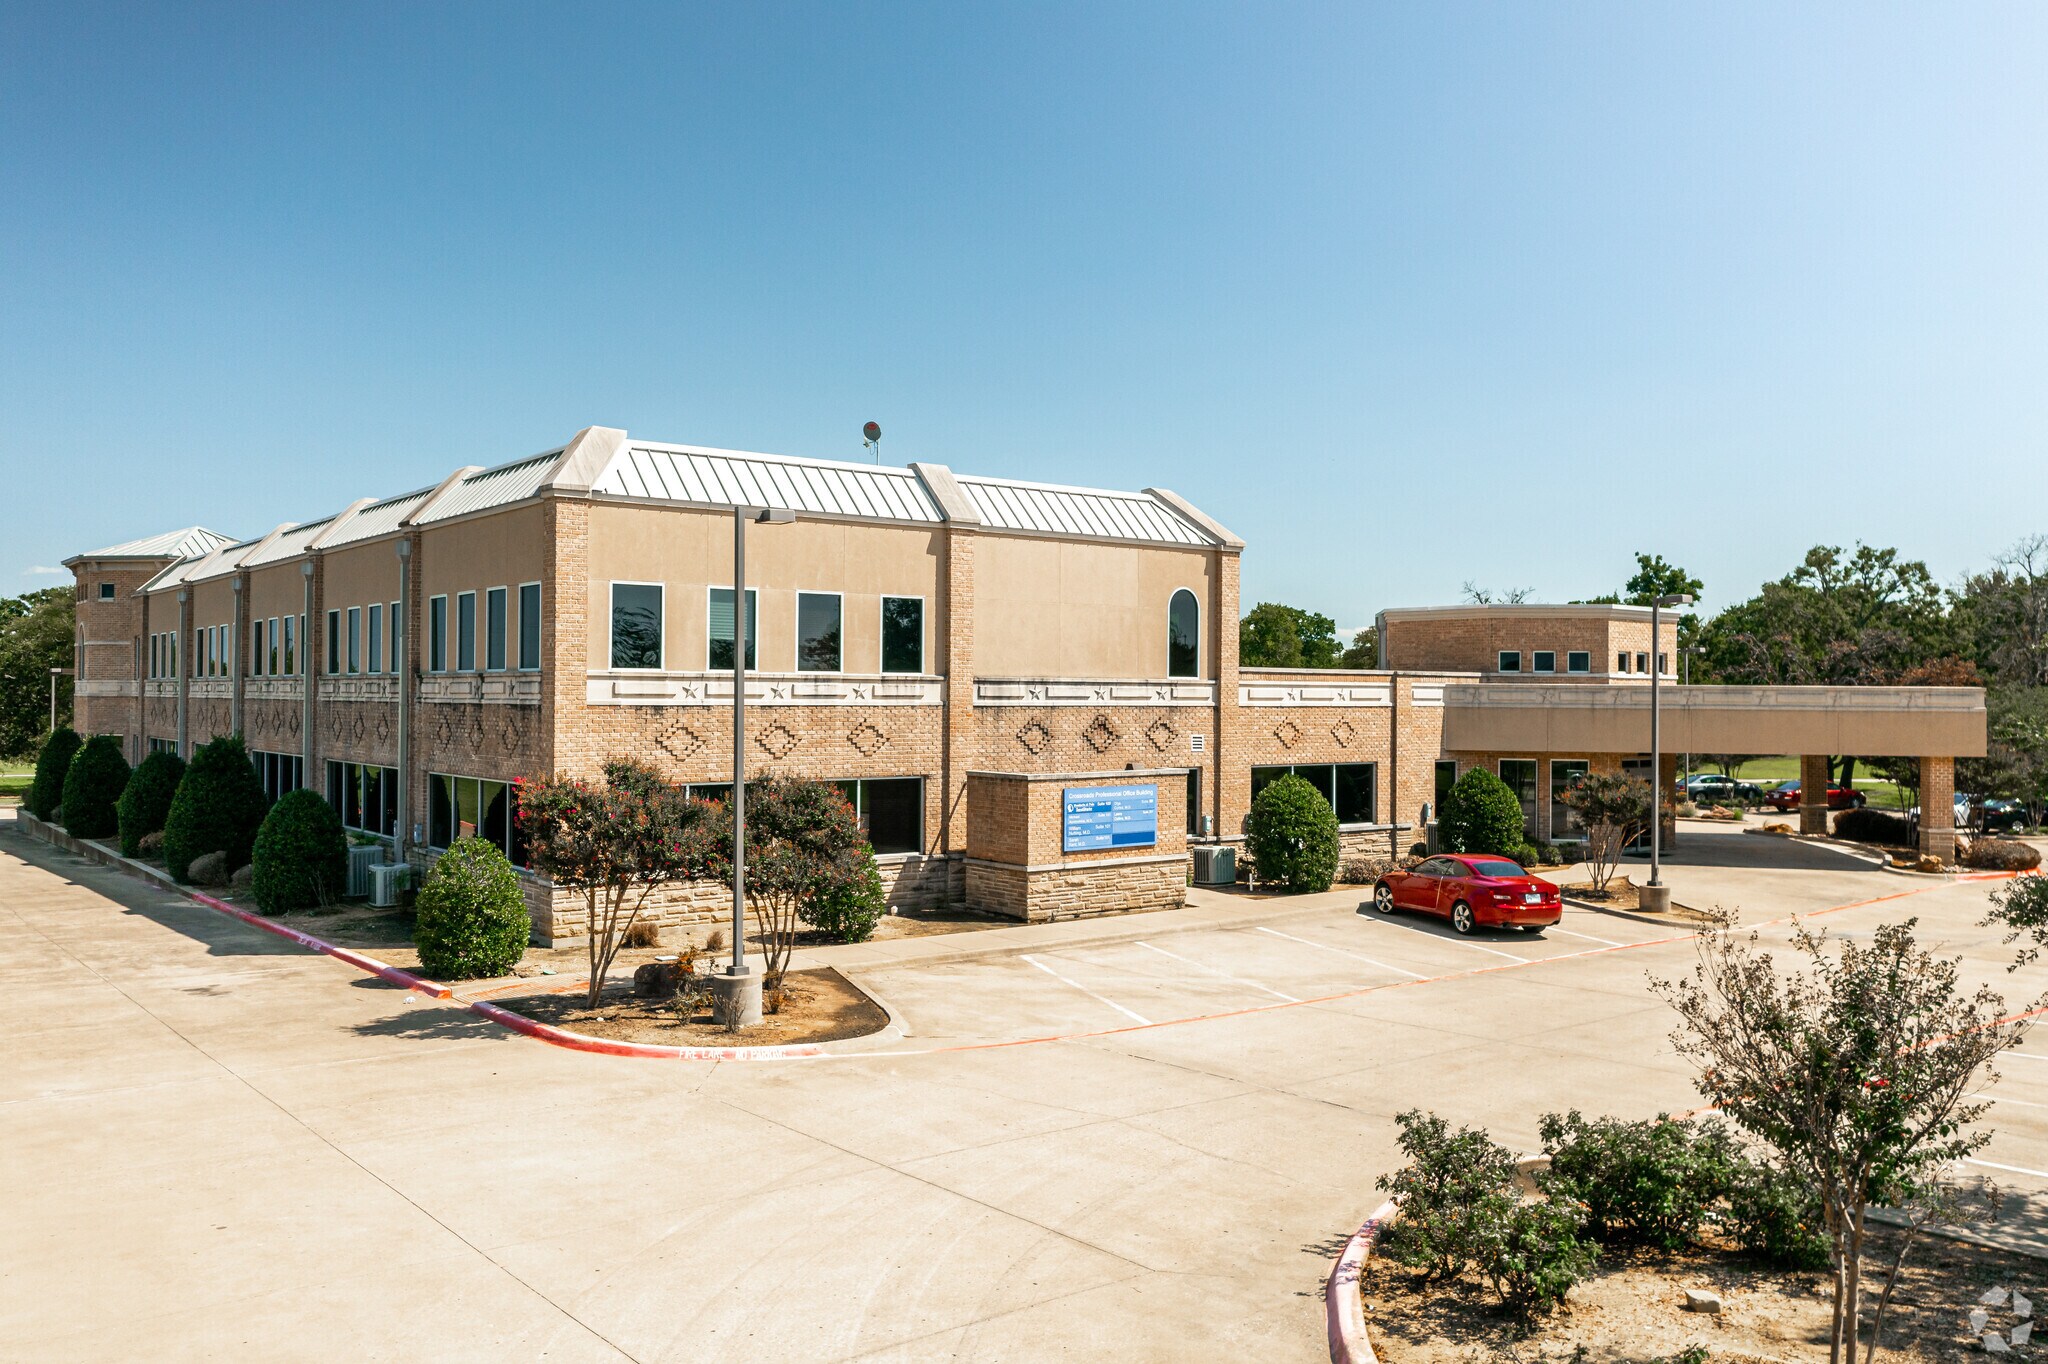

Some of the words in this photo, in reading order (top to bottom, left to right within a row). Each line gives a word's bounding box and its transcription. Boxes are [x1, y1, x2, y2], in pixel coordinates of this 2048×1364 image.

[679, 1049, 698, 1059] FIRE
[702, 1049, 725, 1059] LANE
[735, 1049, 747, 1059] NO
[750, 1049, 786, 1059] PARKING
